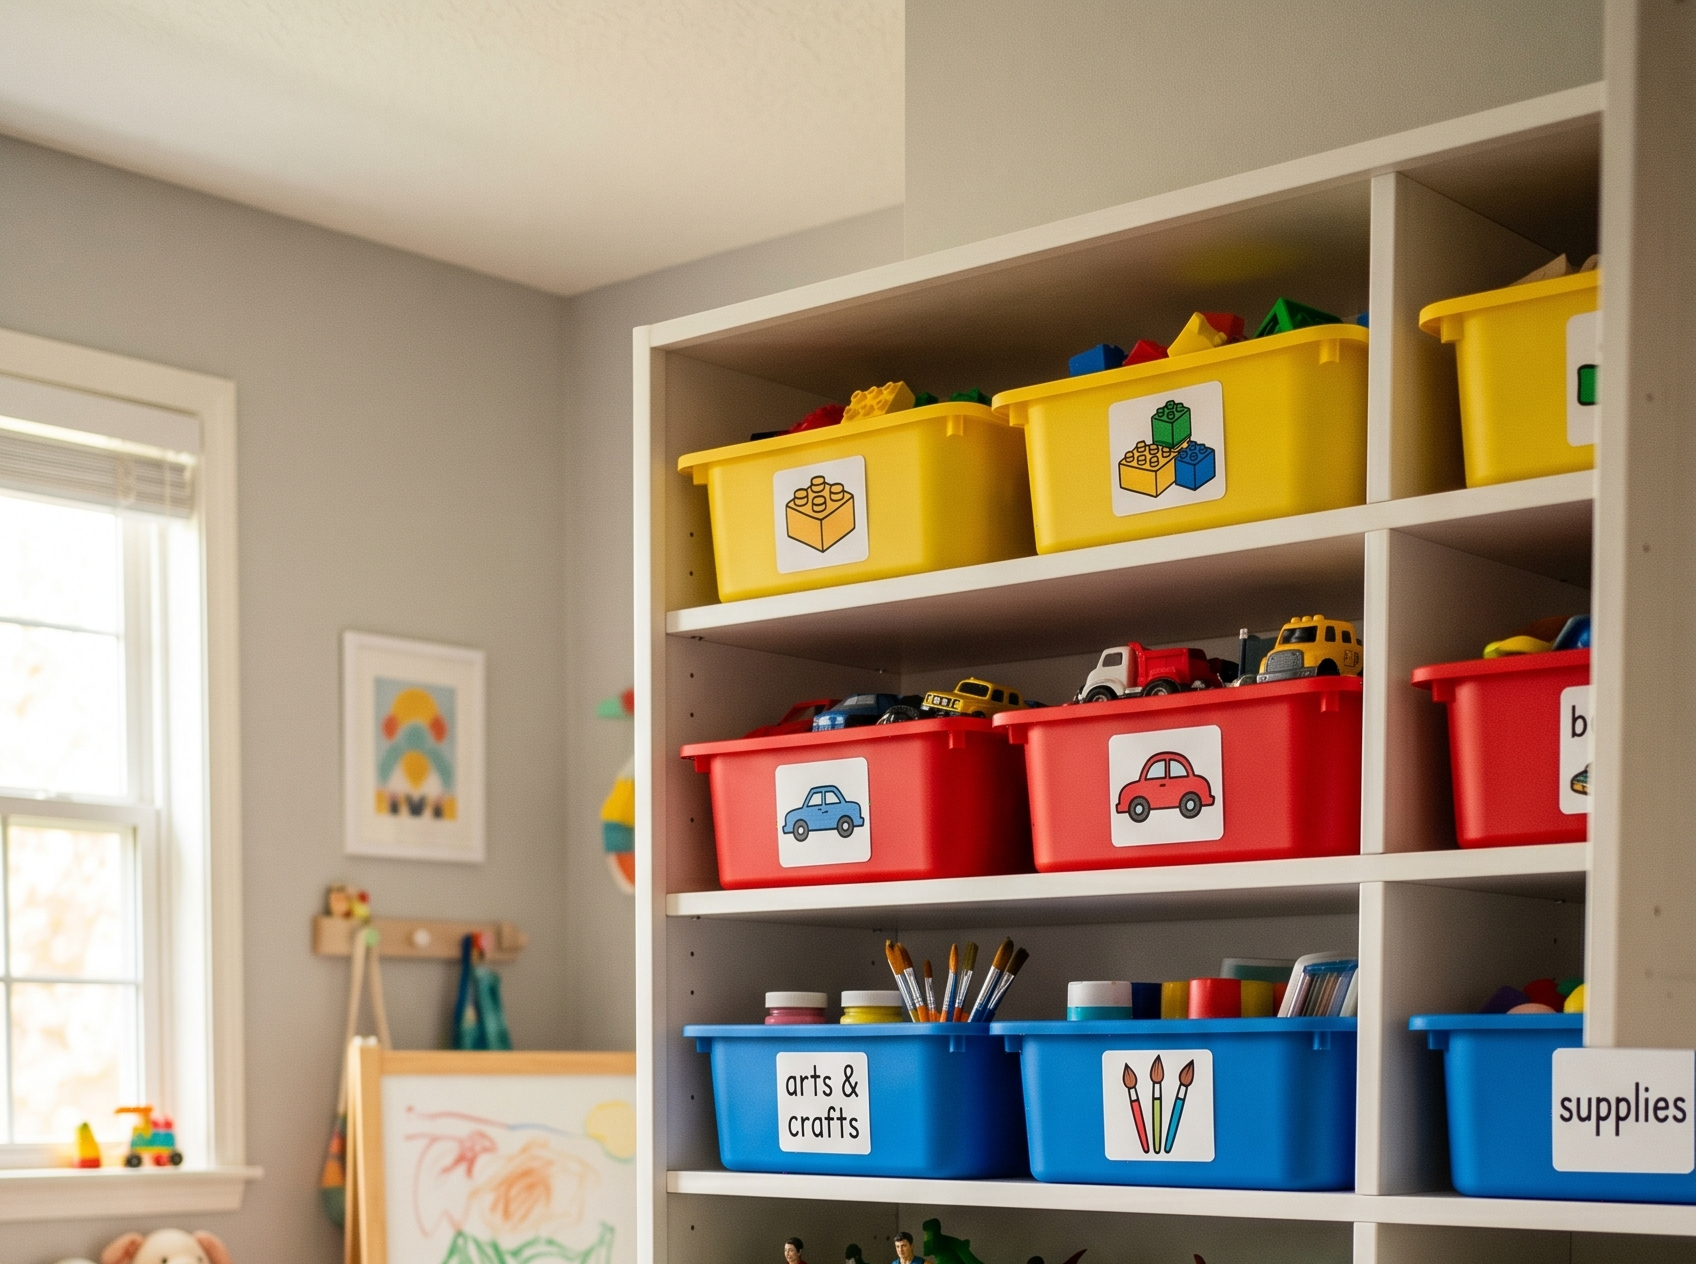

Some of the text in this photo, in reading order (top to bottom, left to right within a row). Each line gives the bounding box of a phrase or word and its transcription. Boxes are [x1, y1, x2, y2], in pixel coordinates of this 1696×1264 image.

[1571, 704, 1593, 738] b
[785, 1064, 859, 1098] arts &
[788, 1106, 860, 1139] crafts
[1559, 1081, 1687, 1137] supplies
